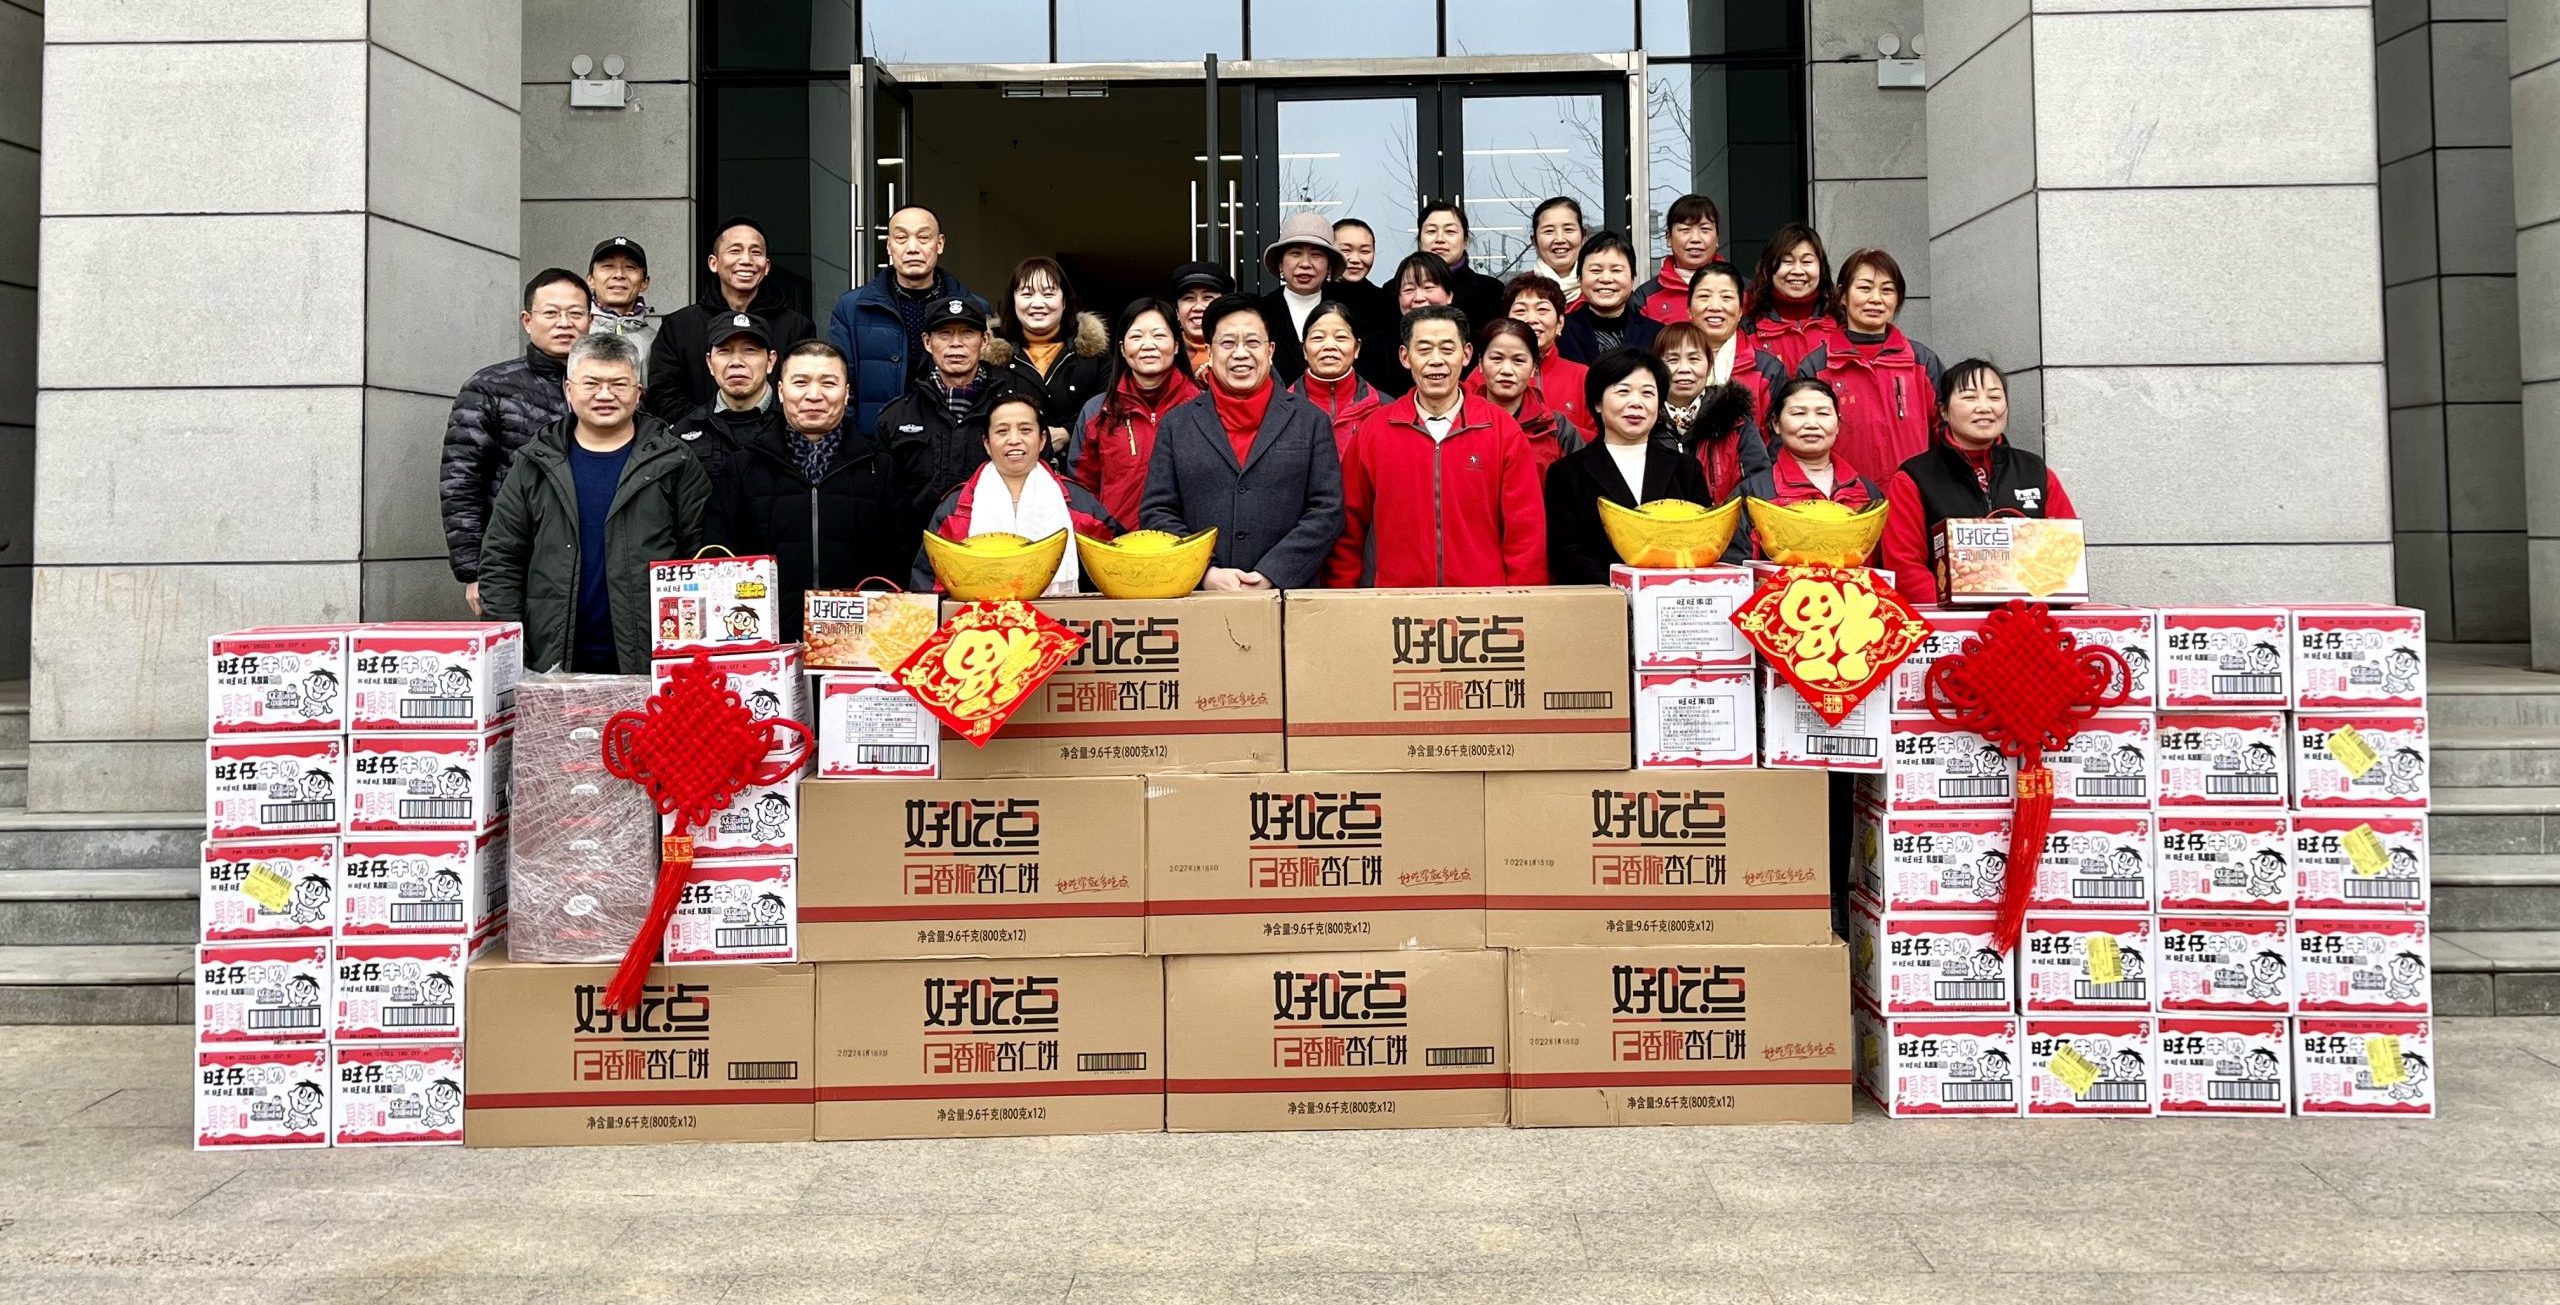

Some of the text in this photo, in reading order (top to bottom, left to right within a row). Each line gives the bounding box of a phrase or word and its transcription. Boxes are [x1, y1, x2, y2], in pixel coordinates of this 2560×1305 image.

[1956, 526, 2010, 546] 好吃点
[656, 561, 736, 582] 旺仔牛奶
[813, 600, 865, 620] 好吃点
[1392, 615, 1525, 664] 好吃点
[1779, 578, 1885, 682] 福
[2169, 632, 2246, 651] 旺仔牛奶
[2303, 632, 2382, 650] 旺仔牛奶
[218, 655, 301, 675] 旺仔牛奶
[358, 655, 439, 674] 旺仔牛奶
[943, 627, 1041, 718] 福
[1896, 736, 1974, 754] 旺仔牛奶
[2161, 733, 2242, 751] 旺仔牛奶
[216, 760, 300, 780] 旺仔牛奶
[357, 756, 438, 774] 旺仔牛奶
[904, 798, 1040, 848] 好吃点
[1249, 791, 1382, 841] 好吃点
[1592, 789, 1726, 839] 好吃点
[1894, 836, 1972, 854] 旺仔牛奶
[2164, 833, 2246, 852] 旺仔牛奶
[2298, 836, 2340, 854] 旺仔
[211, 860, 293, 880] 旺仔奶
[348, 860, 428, 878] 旺仔牛奶
[1892, 938, 1970, 956] 旺仔牛奶
[2032, 937, 2087, 954] 旺仔牛
[2164, 934, 2246, 953] 旺仔牛奶
[2301, 935, 2385, 953] 旺仔牛奶
[205, 965, 286, 984] 旺仔牛奶
[340, 963, 420, 982] 旺仔牛奶
[1273, 970, 1407, 1020] 好吃点
[1612, 965, 1746, 1014] 好吃点
[574, 983, 710, 1033] 好吃点
[924, 976, 1059, 1027] 好吃点
[1899, 1040, 1977, 1057] 旺仔牛奶
[2164, 1037, 2244, 1055] 旺仔牛奶
[2304, 1037, 2367, 1054] 旺仔牛
[204, 1066, 284, 1086] 旺仔牛奶
[342, 1064, 423, 1084] 旺仔牛奶
